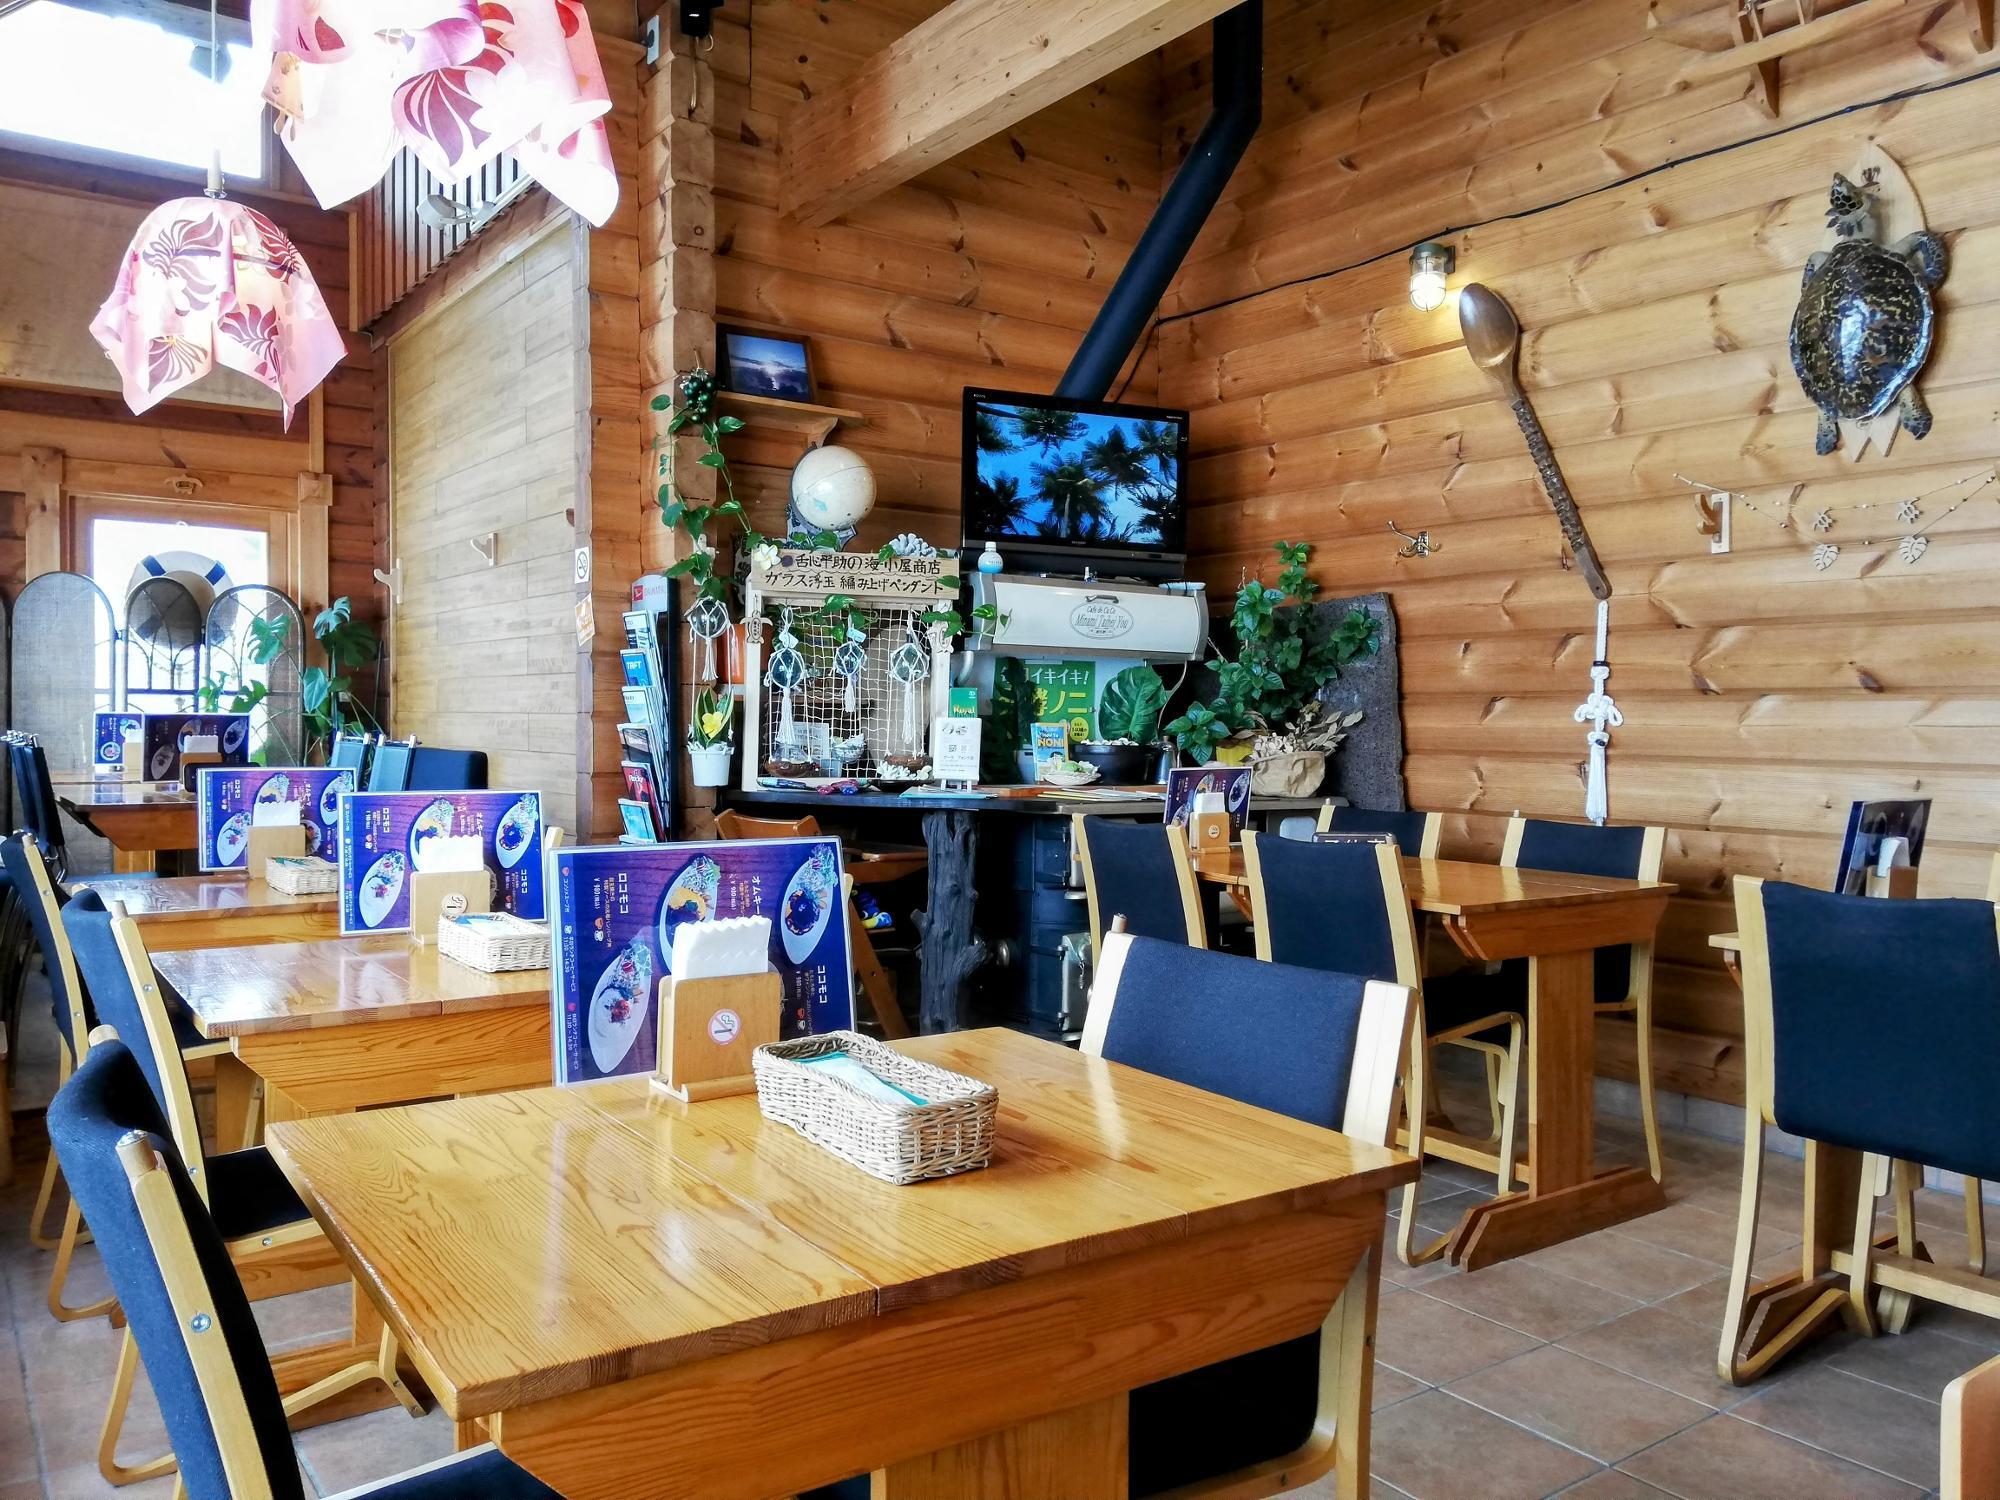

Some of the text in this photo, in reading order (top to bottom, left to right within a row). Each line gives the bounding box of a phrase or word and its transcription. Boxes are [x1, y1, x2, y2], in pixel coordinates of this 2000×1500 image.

[618, 873, 629, 914] ロコモコ
[752, 876, 762, 920] オムキー
[817, 965, 828, 1004] ココモコ
